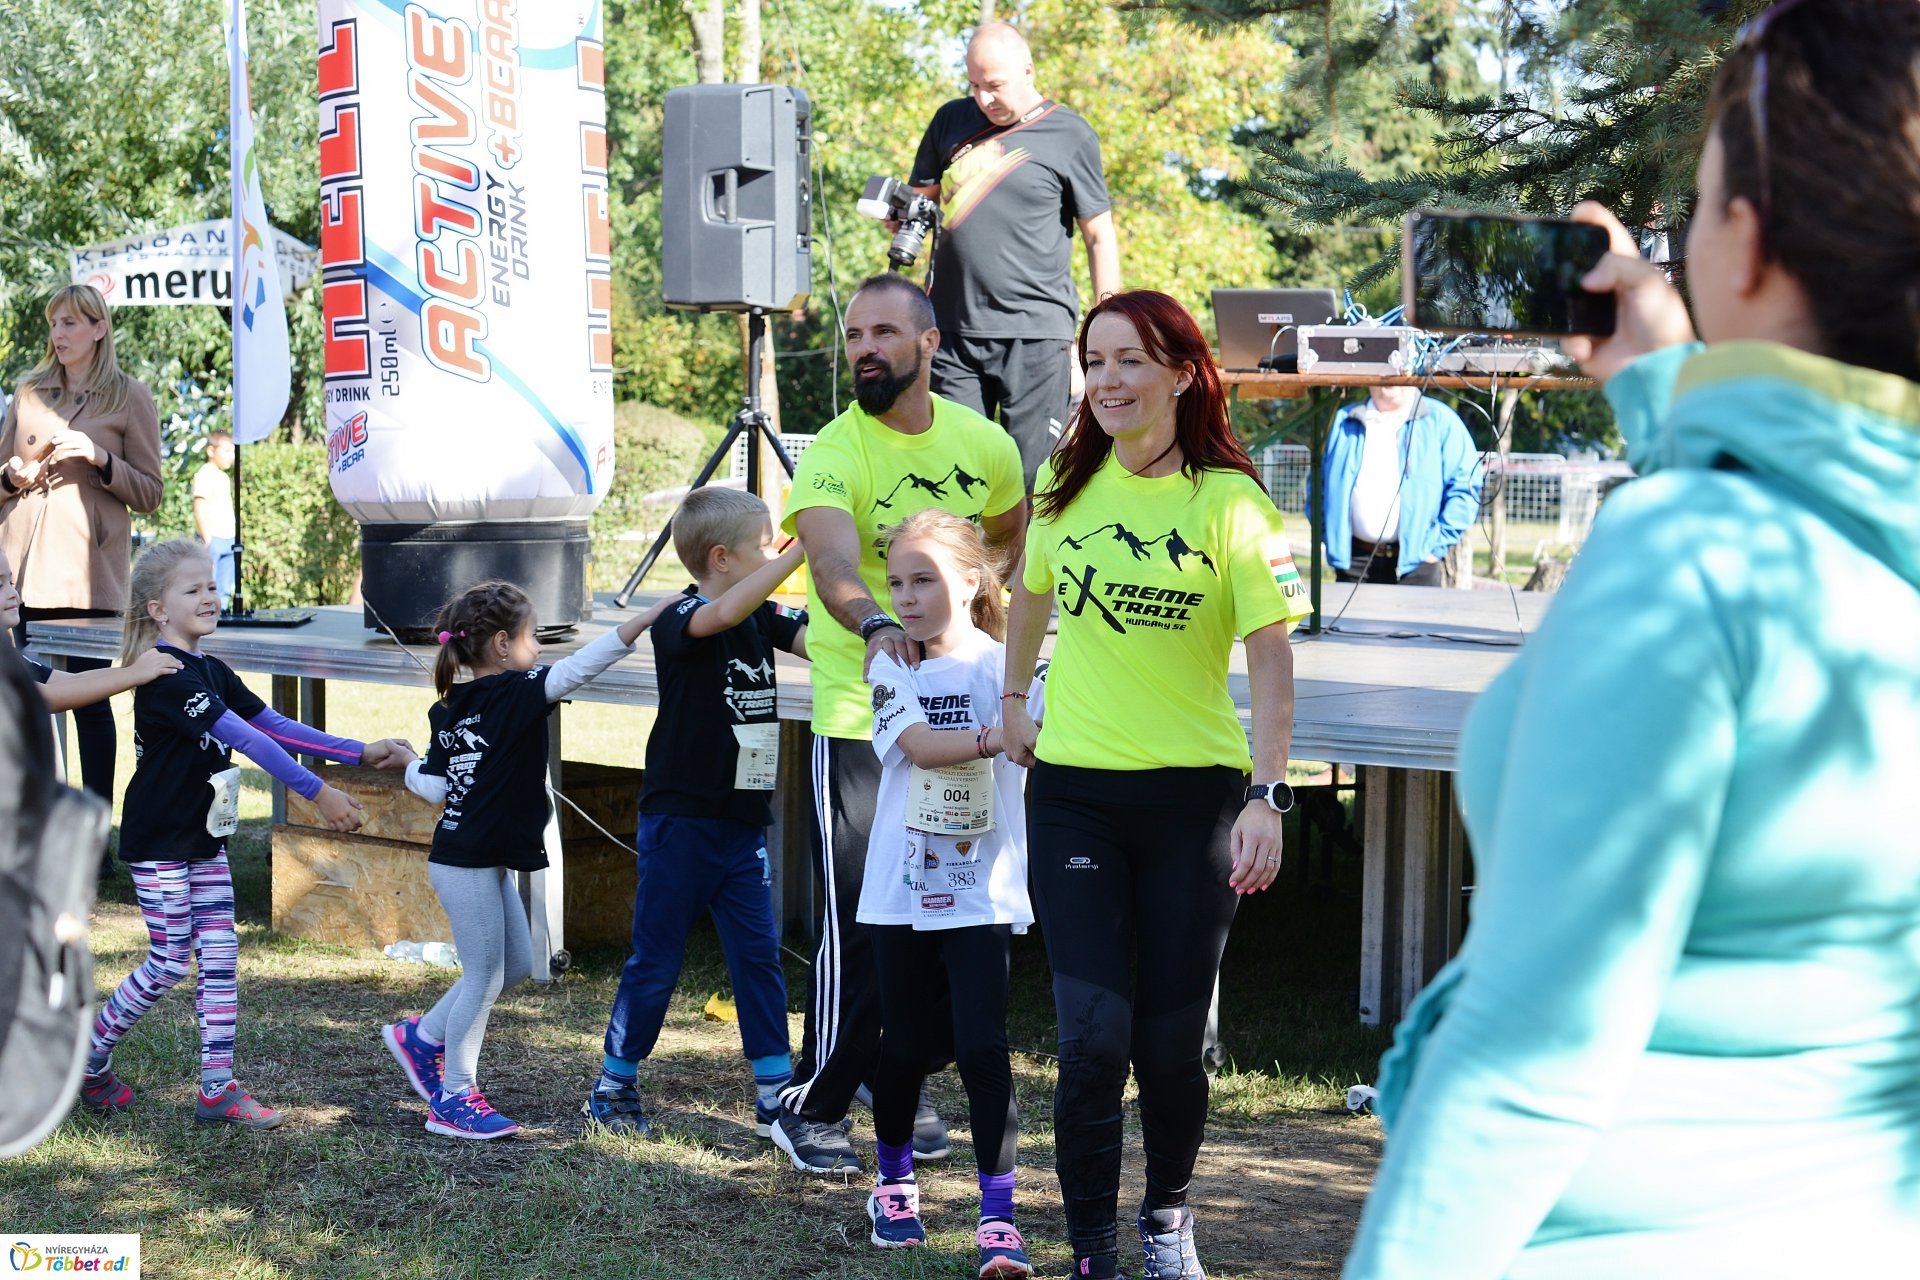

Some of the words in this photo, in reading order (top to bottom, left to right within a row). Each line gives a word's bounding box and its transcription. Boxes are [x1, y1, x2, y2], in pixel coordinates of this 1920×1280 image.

[407, 7, 488, 381] ACTIVE
[486, 168, 511, 308] ENERGY
[508, 180, 530, 281] DRINK
[335, 386, 371, 402] DRINK
[1111, 600, 1192, 621] TRAIL
[943, 789, 971, 802] 004
[948, 870, 977, 888] 383
